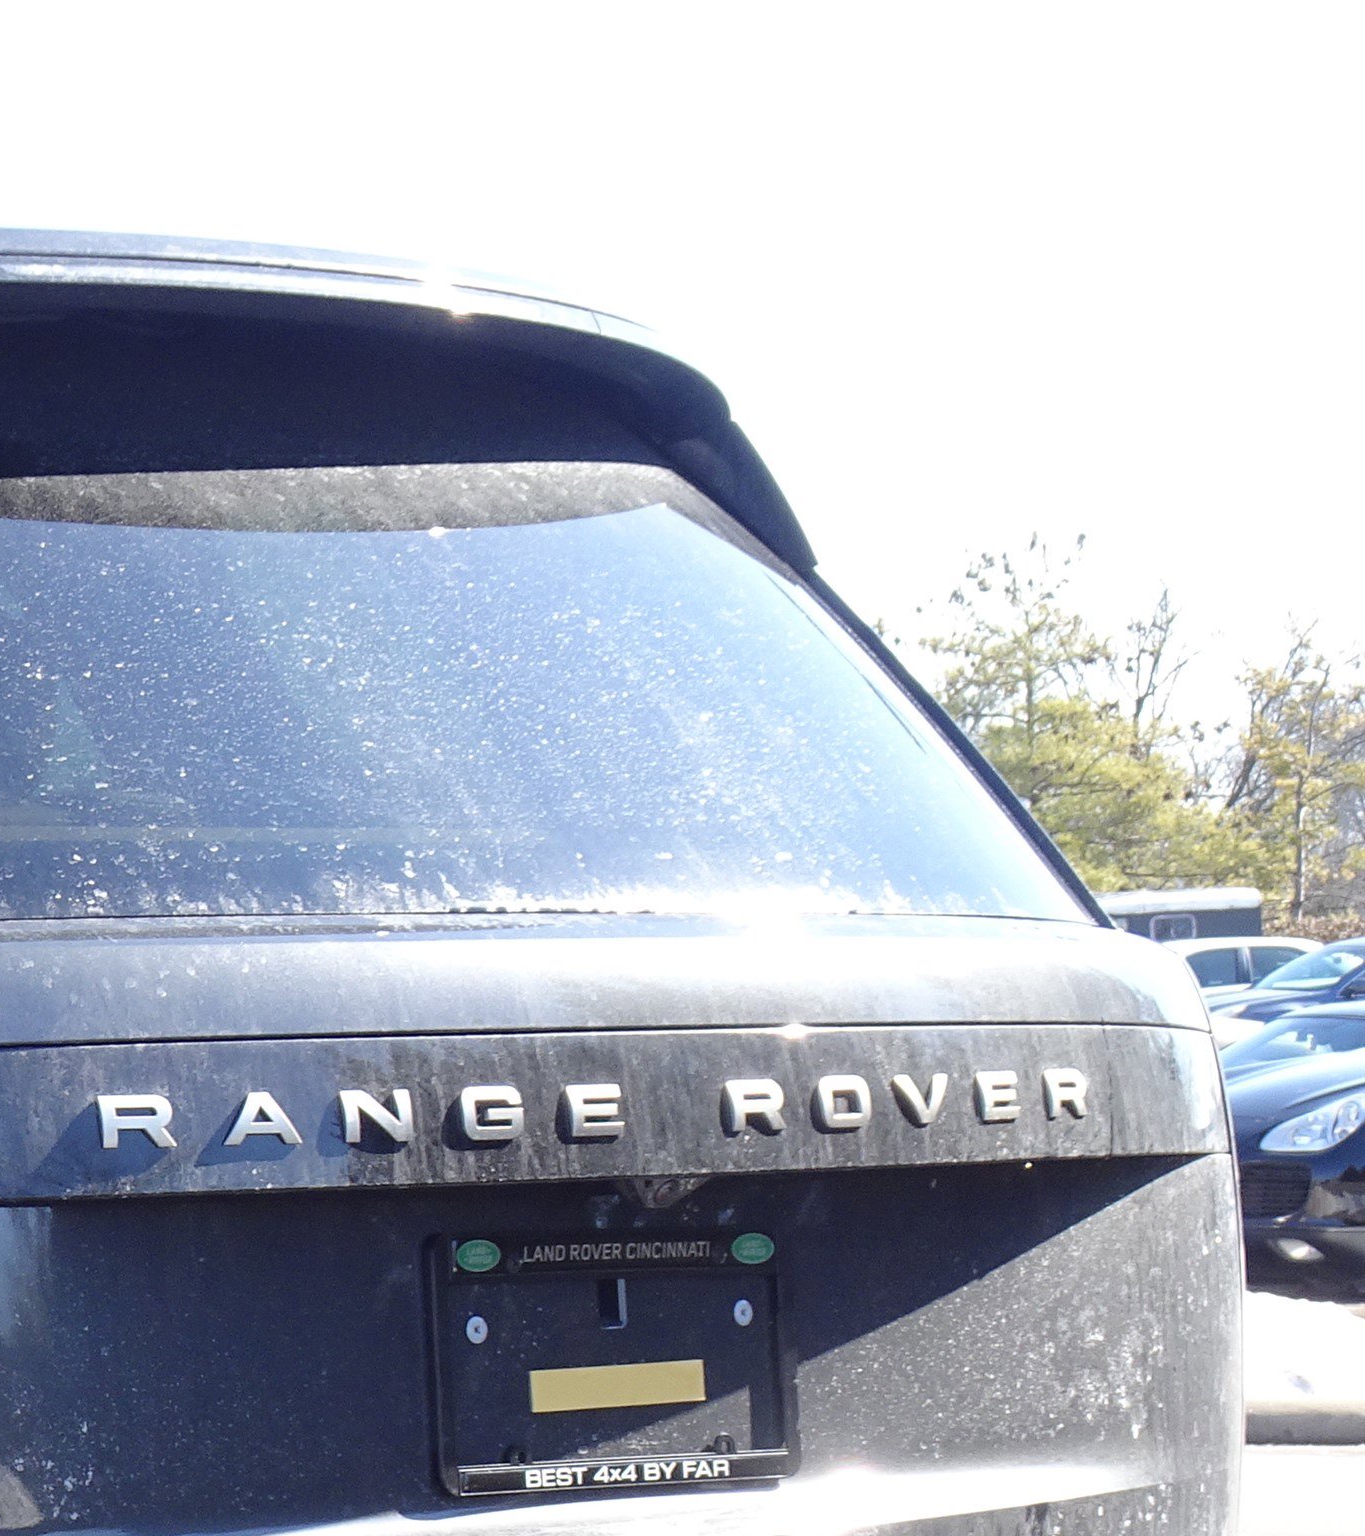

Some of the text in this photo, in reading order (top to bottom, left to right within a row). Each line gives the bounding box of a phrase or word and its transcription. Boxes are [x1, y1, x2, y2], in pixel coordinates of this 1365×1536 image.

[96, 1067, 1091, 1150] RANGE ROVER
[522, 1240, 711, 1263] LAND ROVER CINCINNATI
[525, 1459, 730, 1488] BEST 4x4 BY FAR
